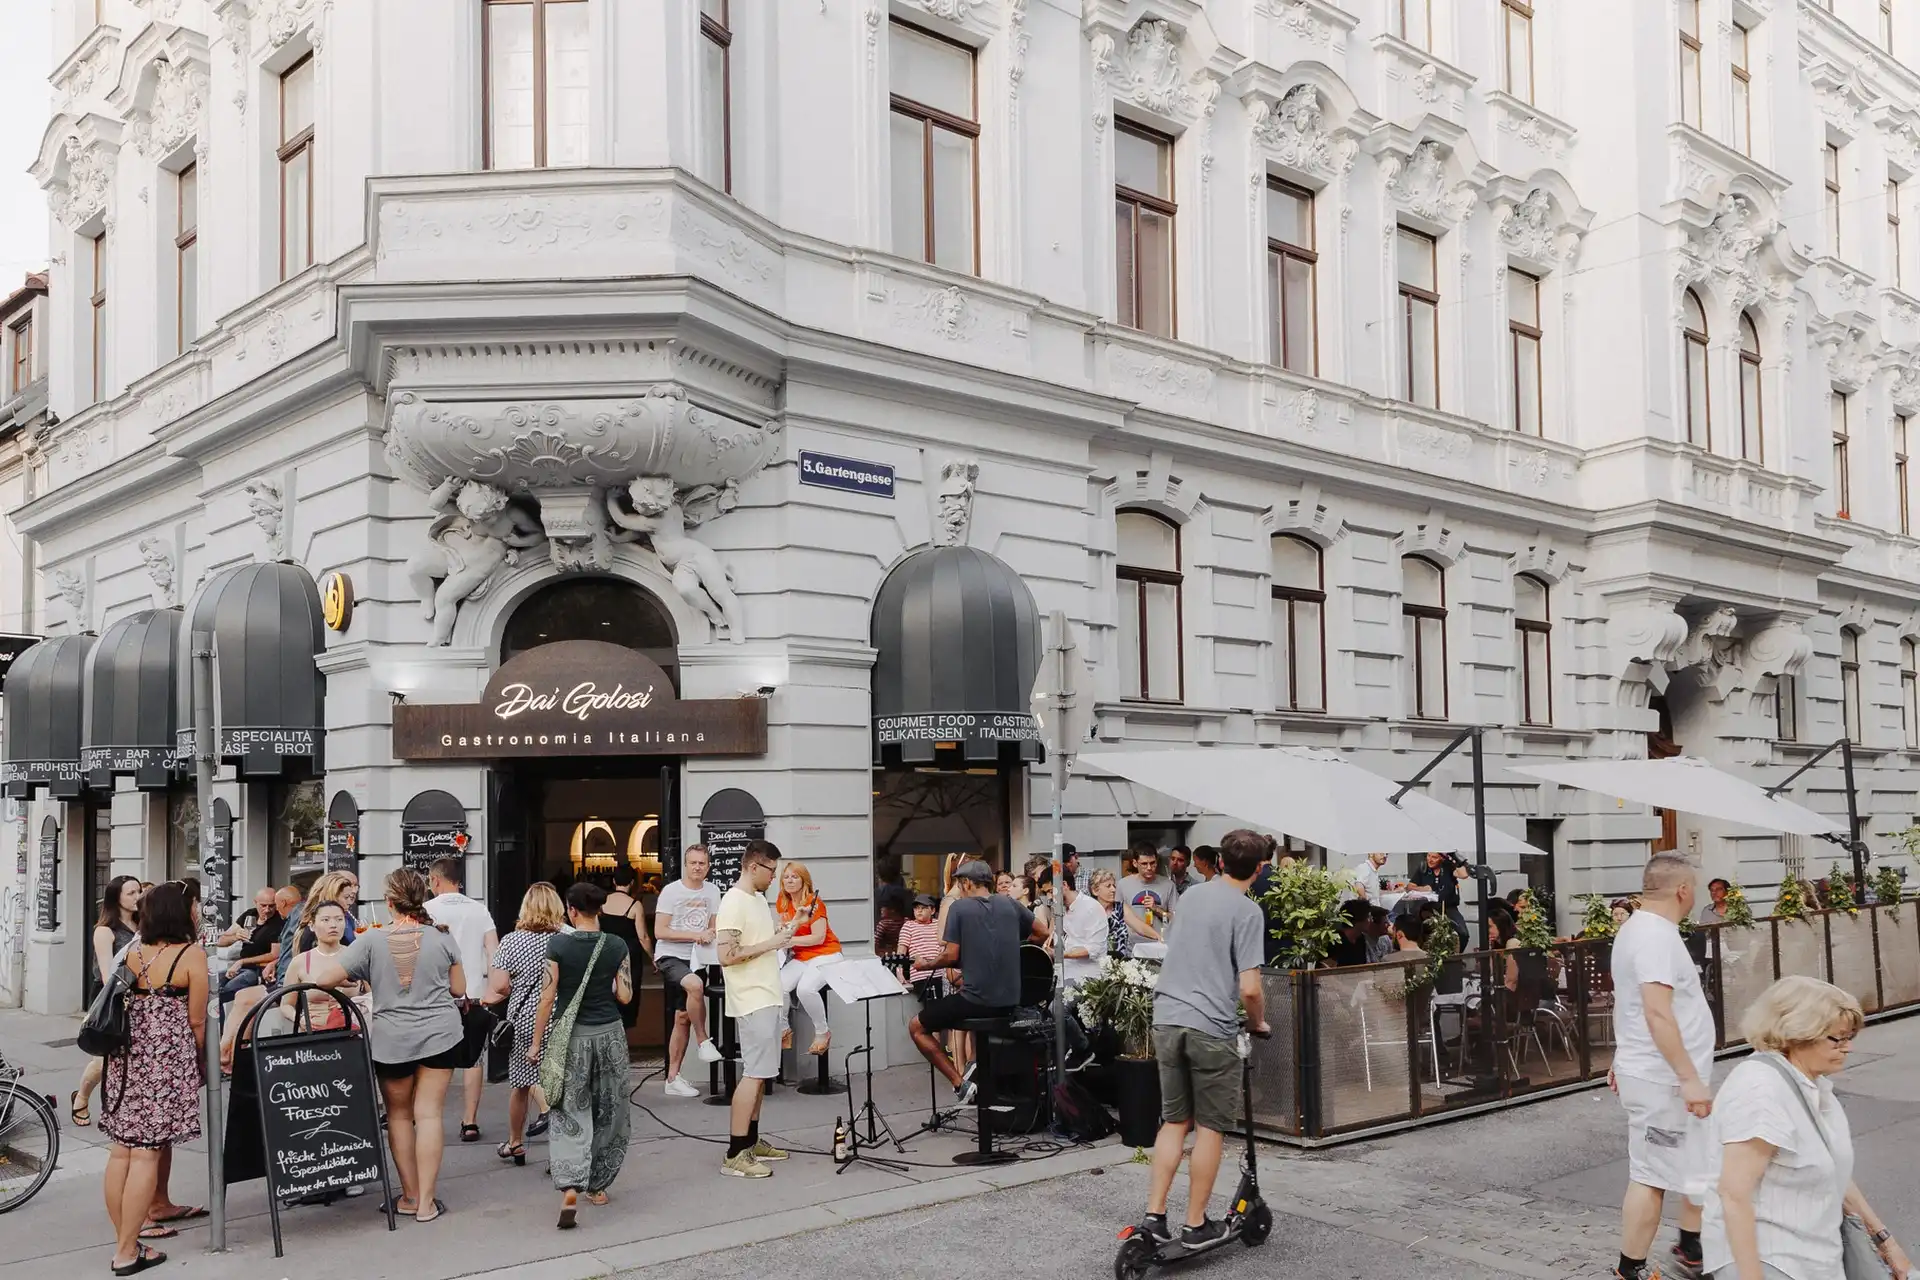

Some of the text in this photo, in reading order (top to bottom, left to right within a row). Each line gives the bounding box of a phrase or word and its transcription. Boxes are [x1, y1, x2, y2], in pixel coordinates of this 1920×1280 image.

[815, 462, 892, 486] Gartengasse
[494, 681, 654, 721] Dai Golosi
[878, 716, 935, 730] GOURMET
[938, 715, 976, 727] FOOD
[231, 730, 313, 742] SPECIALITÀ
[441, 730, 706, 747] Gastronomia Italiana
[879, 727, 963, 742] DELIKATESSEN
[126, 749, 150, 759] BAR
[274, 743, 314, 754] BROT
[113, 760, 143, 769] WEIN
[265, 1050, 342, 1072] jeden Mittwoch
[332, 1078, 353, 1097] del
[280, 1105, 348, 1121] FRESCO
[277, 1139, 373, 1174] frische italienische
[290, 1156, 358, 1178] Spezialitäten
[313, 1179, 327, 1190] der
[328, 1170, 353, 1186] Vorrat
